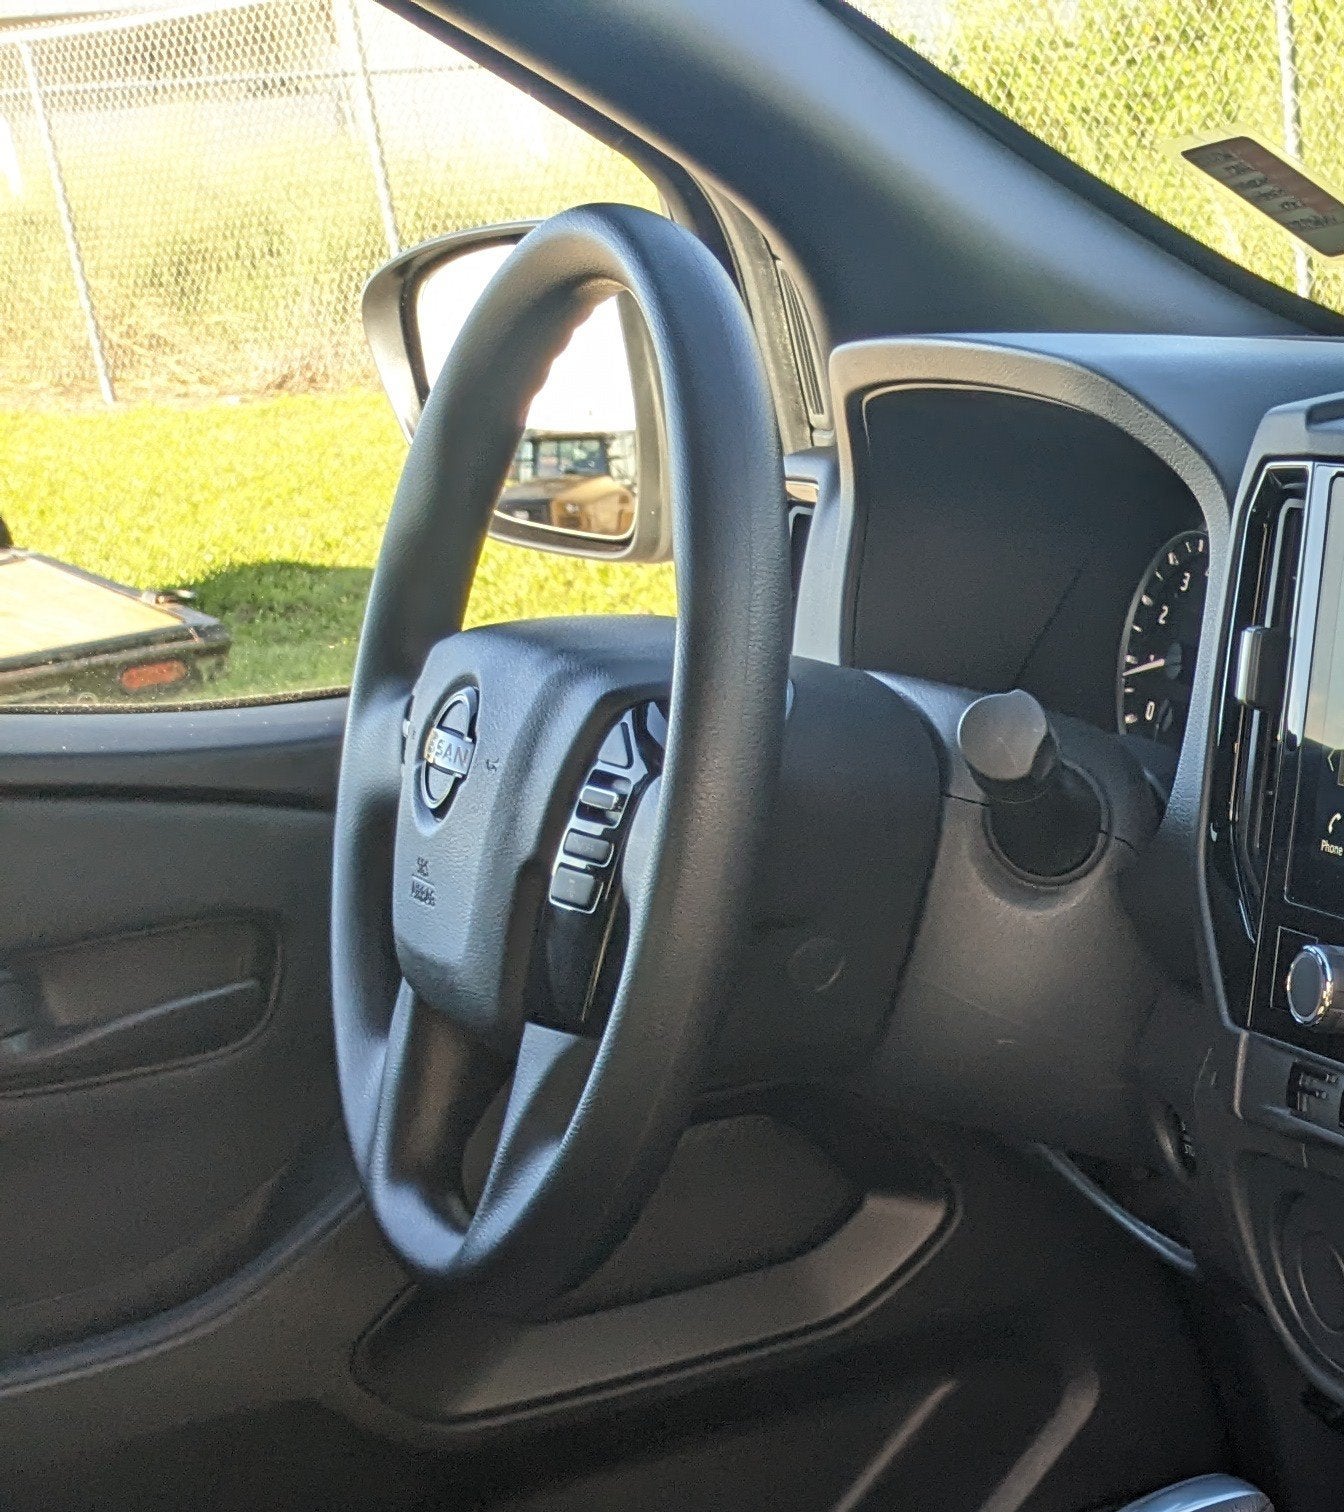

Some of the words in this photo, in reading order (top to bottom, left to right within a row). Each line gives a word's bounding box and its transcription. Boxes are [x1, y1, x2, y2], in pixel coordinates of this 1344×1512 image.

[1180, 572, 1190, 591] 3
[1158, 605, 1169, 625] 2
[1145, 701, 1155, 721] 0
[1321, 839, 1343, 856] Phone
